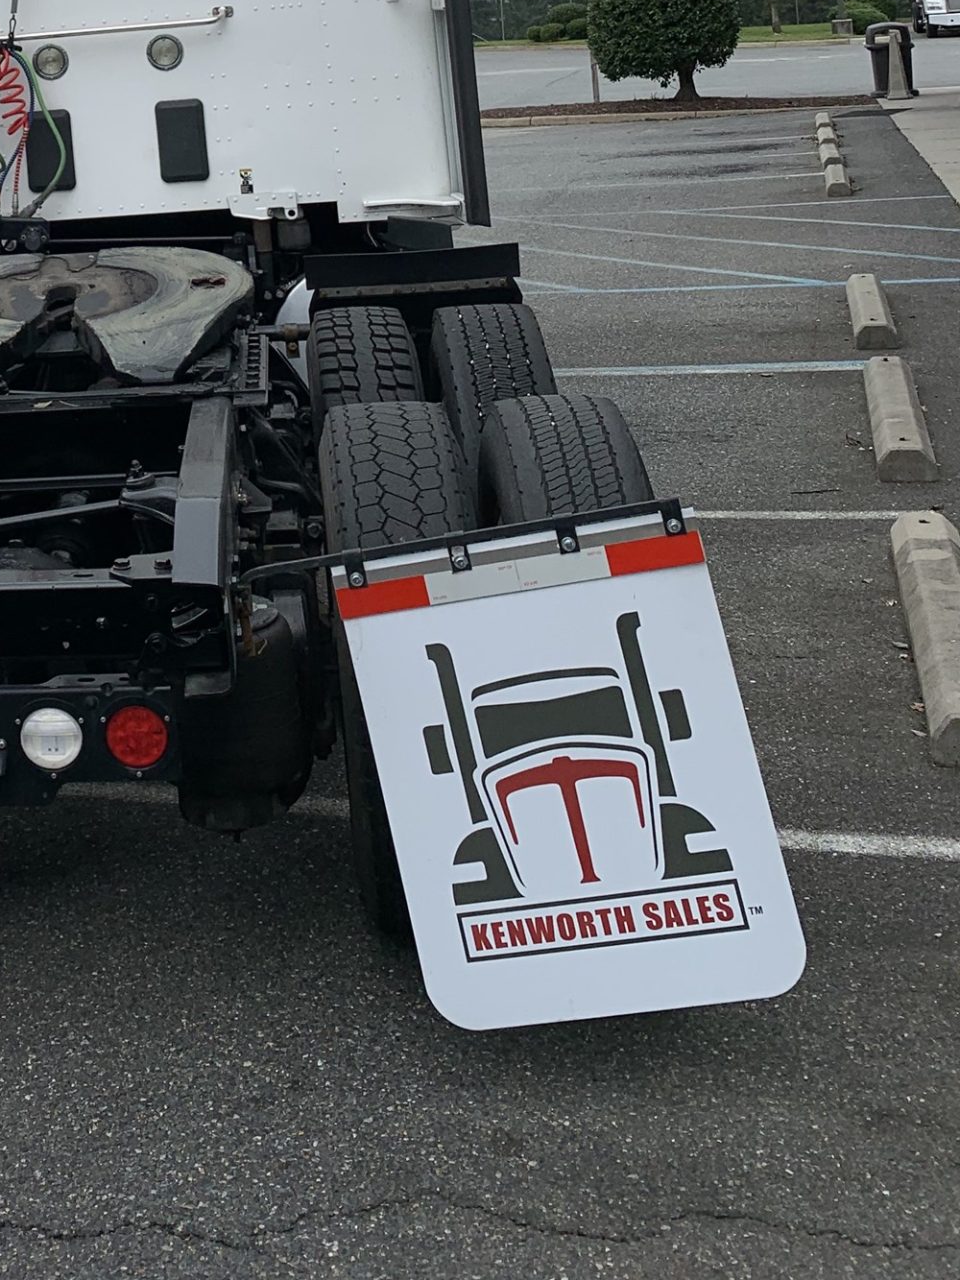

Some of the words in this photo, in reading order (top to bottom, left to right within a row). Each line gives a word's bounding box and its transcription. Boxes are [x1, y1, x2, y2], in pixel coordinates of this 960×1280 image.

[471, 906, 636, 951] KENWORTH
[643, 894, 735, 931] SALES
[748, 905, 764, 916] TM
